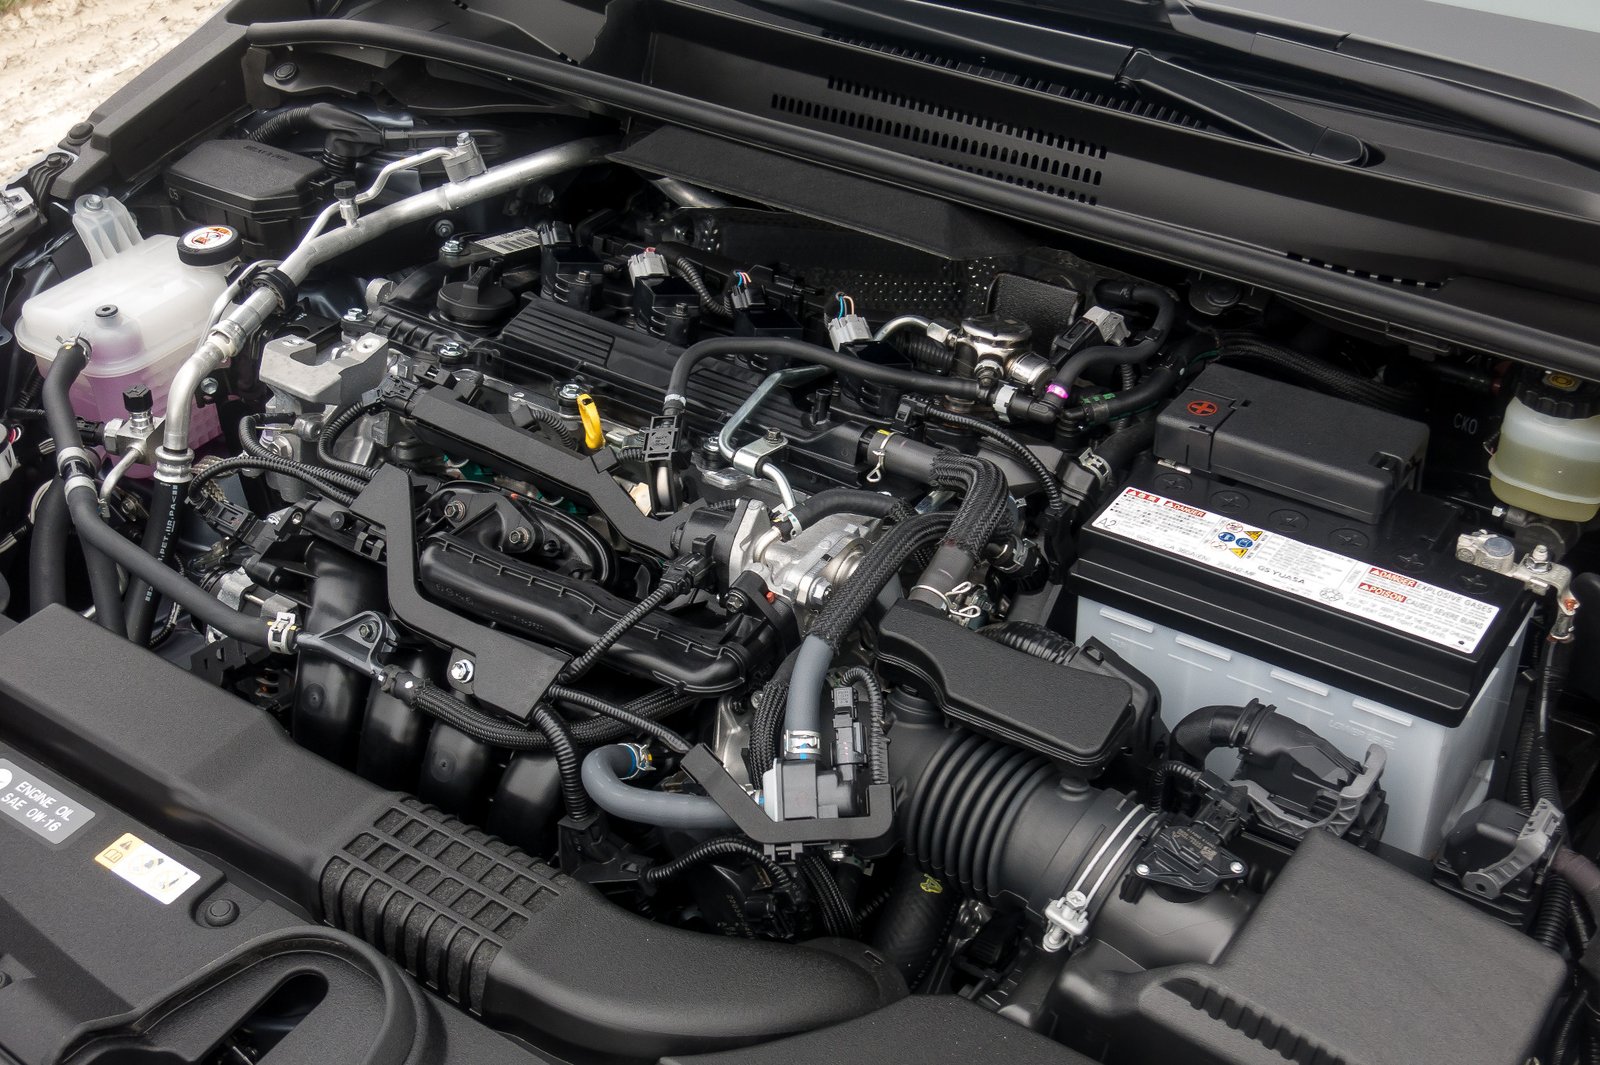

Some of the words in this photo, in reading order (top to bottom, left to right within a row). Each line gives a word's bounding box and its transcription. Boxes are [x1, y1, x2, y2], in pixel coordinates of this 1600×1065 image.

[1098, 517, 1117, 529] A2
[1174, 504, 1206, 518] DANGER
[1258, 565, 1270, 573] GS
[1272, 570, 1305, 584] YUASA
[1380, 570, 1416, 587] DANGER
[1416, 581, 1463, 601] EXPLOSIVE
[1464, 598, 1494, 614] GASES
[1369, 586, 1406, 603] POISON
[1406, 598, 1433, 612] CAUSES
[1434, 606, 1460, 622] SEVERE
[1460, 615, 1484, 630] BURNS
[1, 792, 28, 810] SAE
[26, 808, 62, 832] 0W-16
[15, 781, 57, 808] ENGINE
[55, 805, 74, 821] OIL
